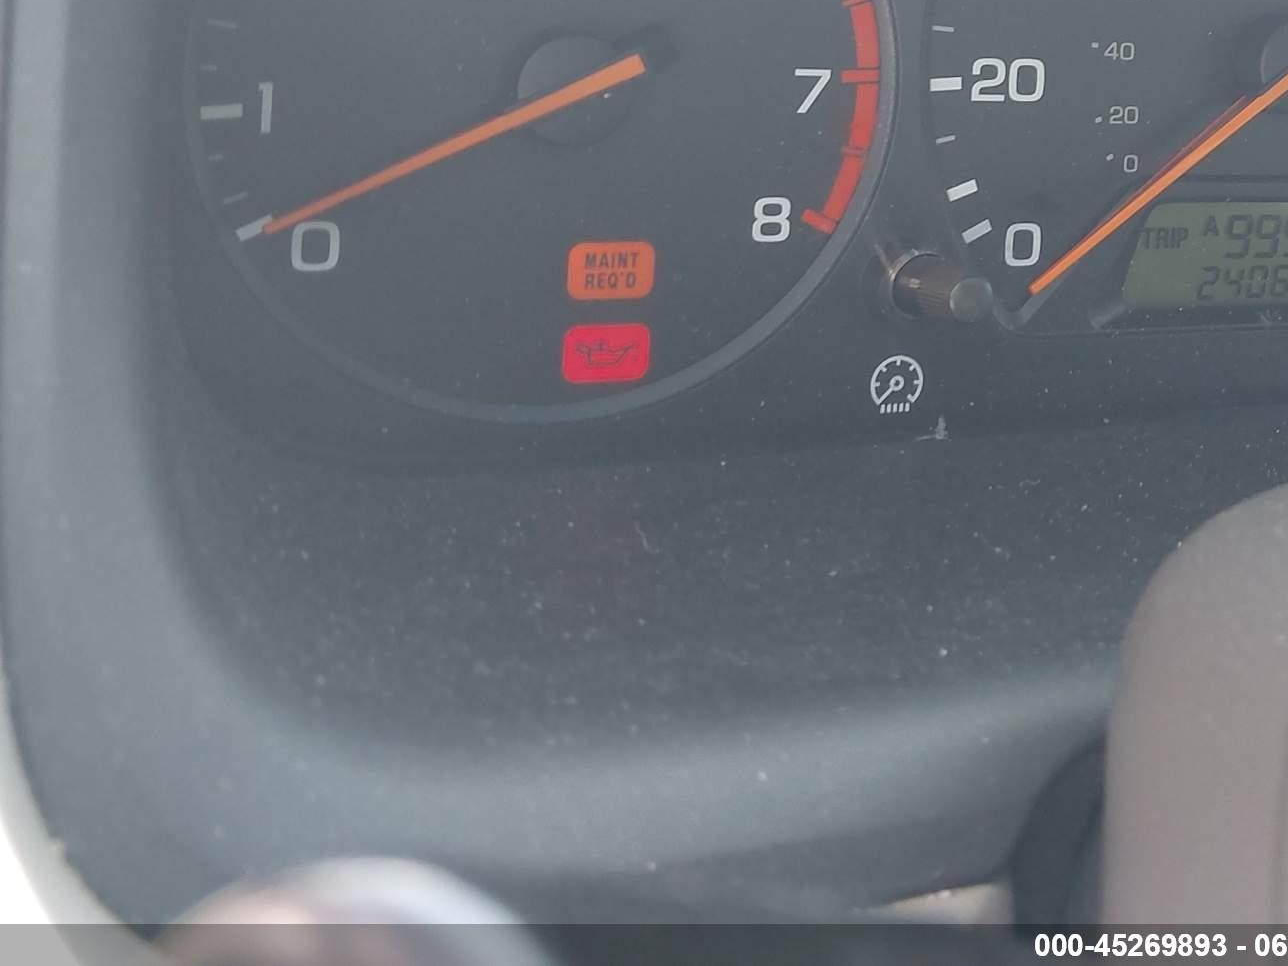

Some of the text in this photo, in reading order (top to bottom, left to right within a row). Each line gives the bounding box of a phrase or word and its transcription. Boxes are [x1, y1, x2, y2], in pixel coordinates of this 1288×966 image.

[1103, 41, 1135, 61] 40
[794, 68, 832, 114] 7
[970, 57, 1045, 102] 20
[258, 81, 274, 134] 1
[1109, 105, 1139, 125] 20
[1123, 154, 1139, 173] 0
[751, 196, 792, 243] 8
[1141, 227, 1189, 249] TRIP
[1204, 215, 1219, 236] A
[291, 221, 340, 272] 0
[584, 252, 640, 268] MAINT
[1004, 222, 1042, 267] 0
[584, 272, 637, 290] REQ'D
